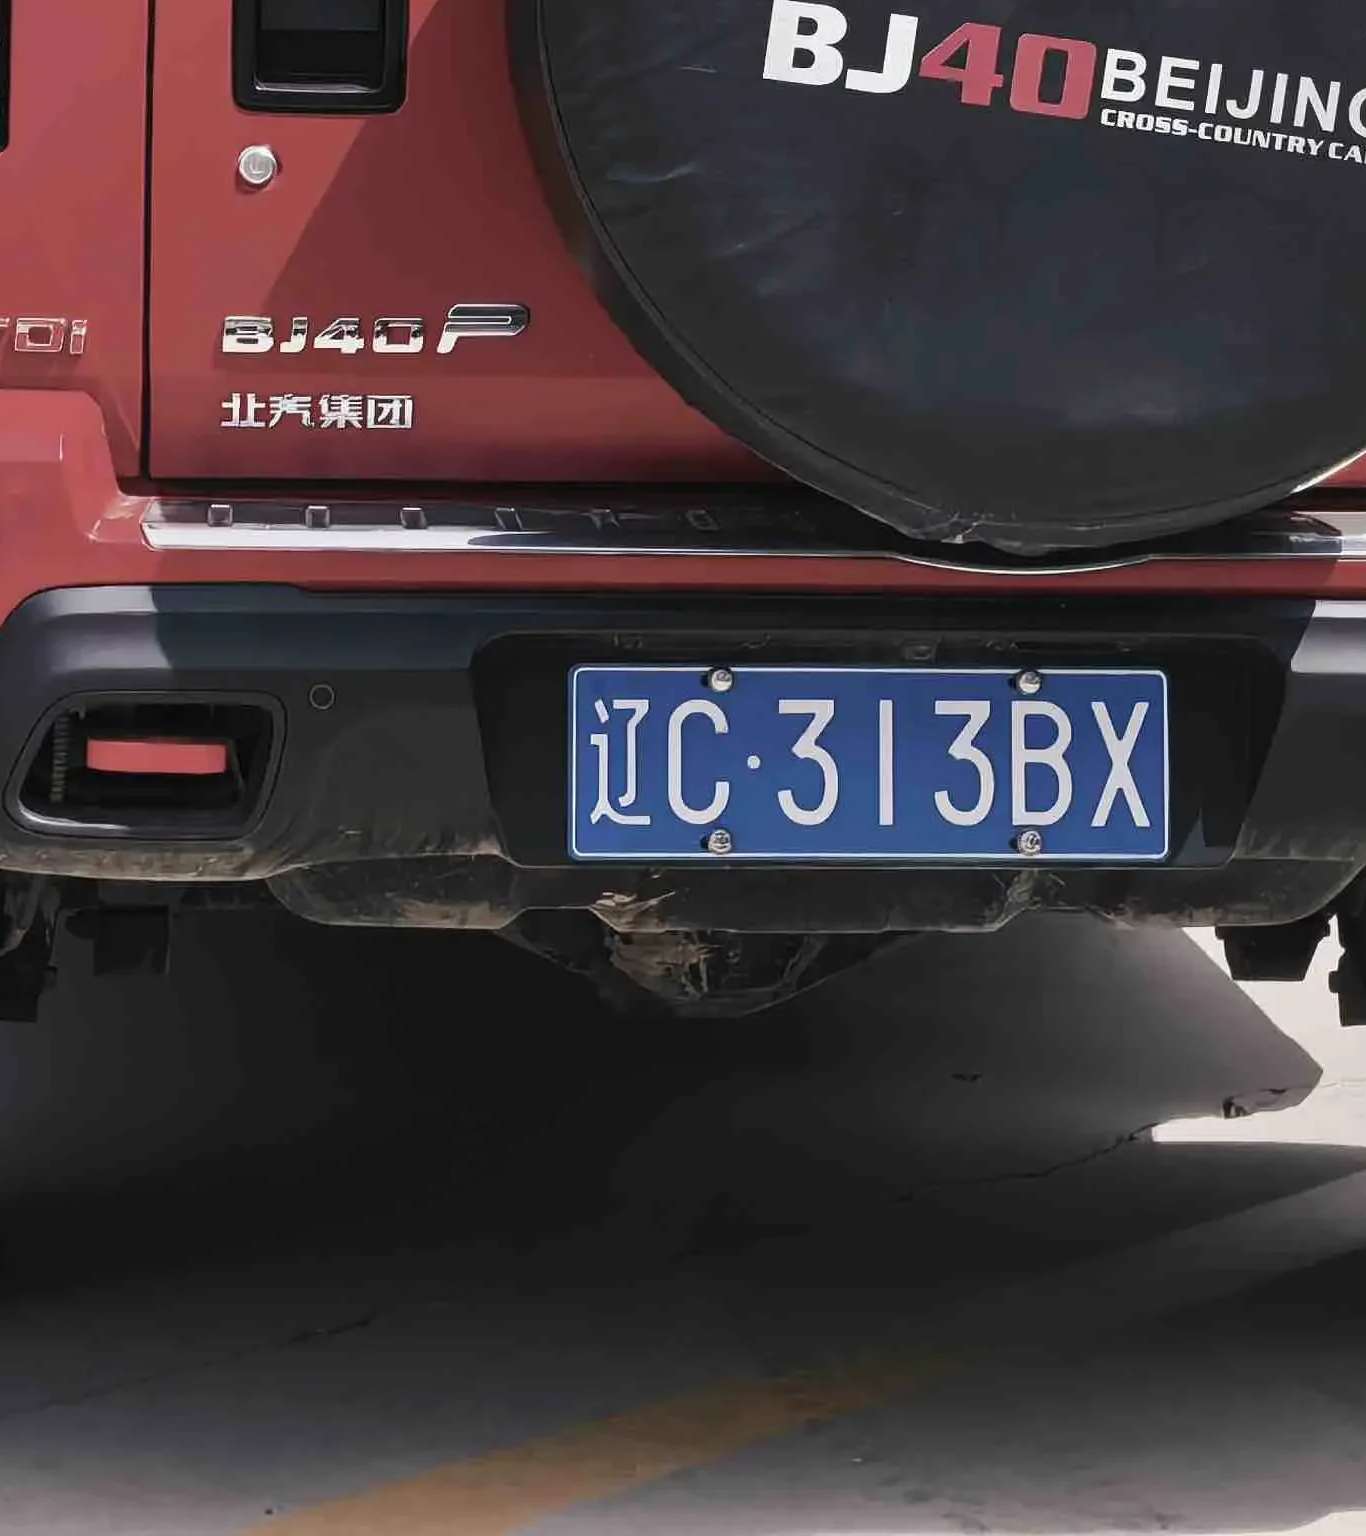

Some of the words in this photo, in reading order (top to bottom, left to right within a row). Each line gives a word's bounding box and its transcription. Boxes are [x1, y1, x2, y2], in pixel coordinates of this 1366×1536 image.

[1100, 108, 1325, 156] CROSS-COUNTRY
[221, 393, 414, 430] 北汽集团
[590, 699, 1151, 827] 辽C·313BX
